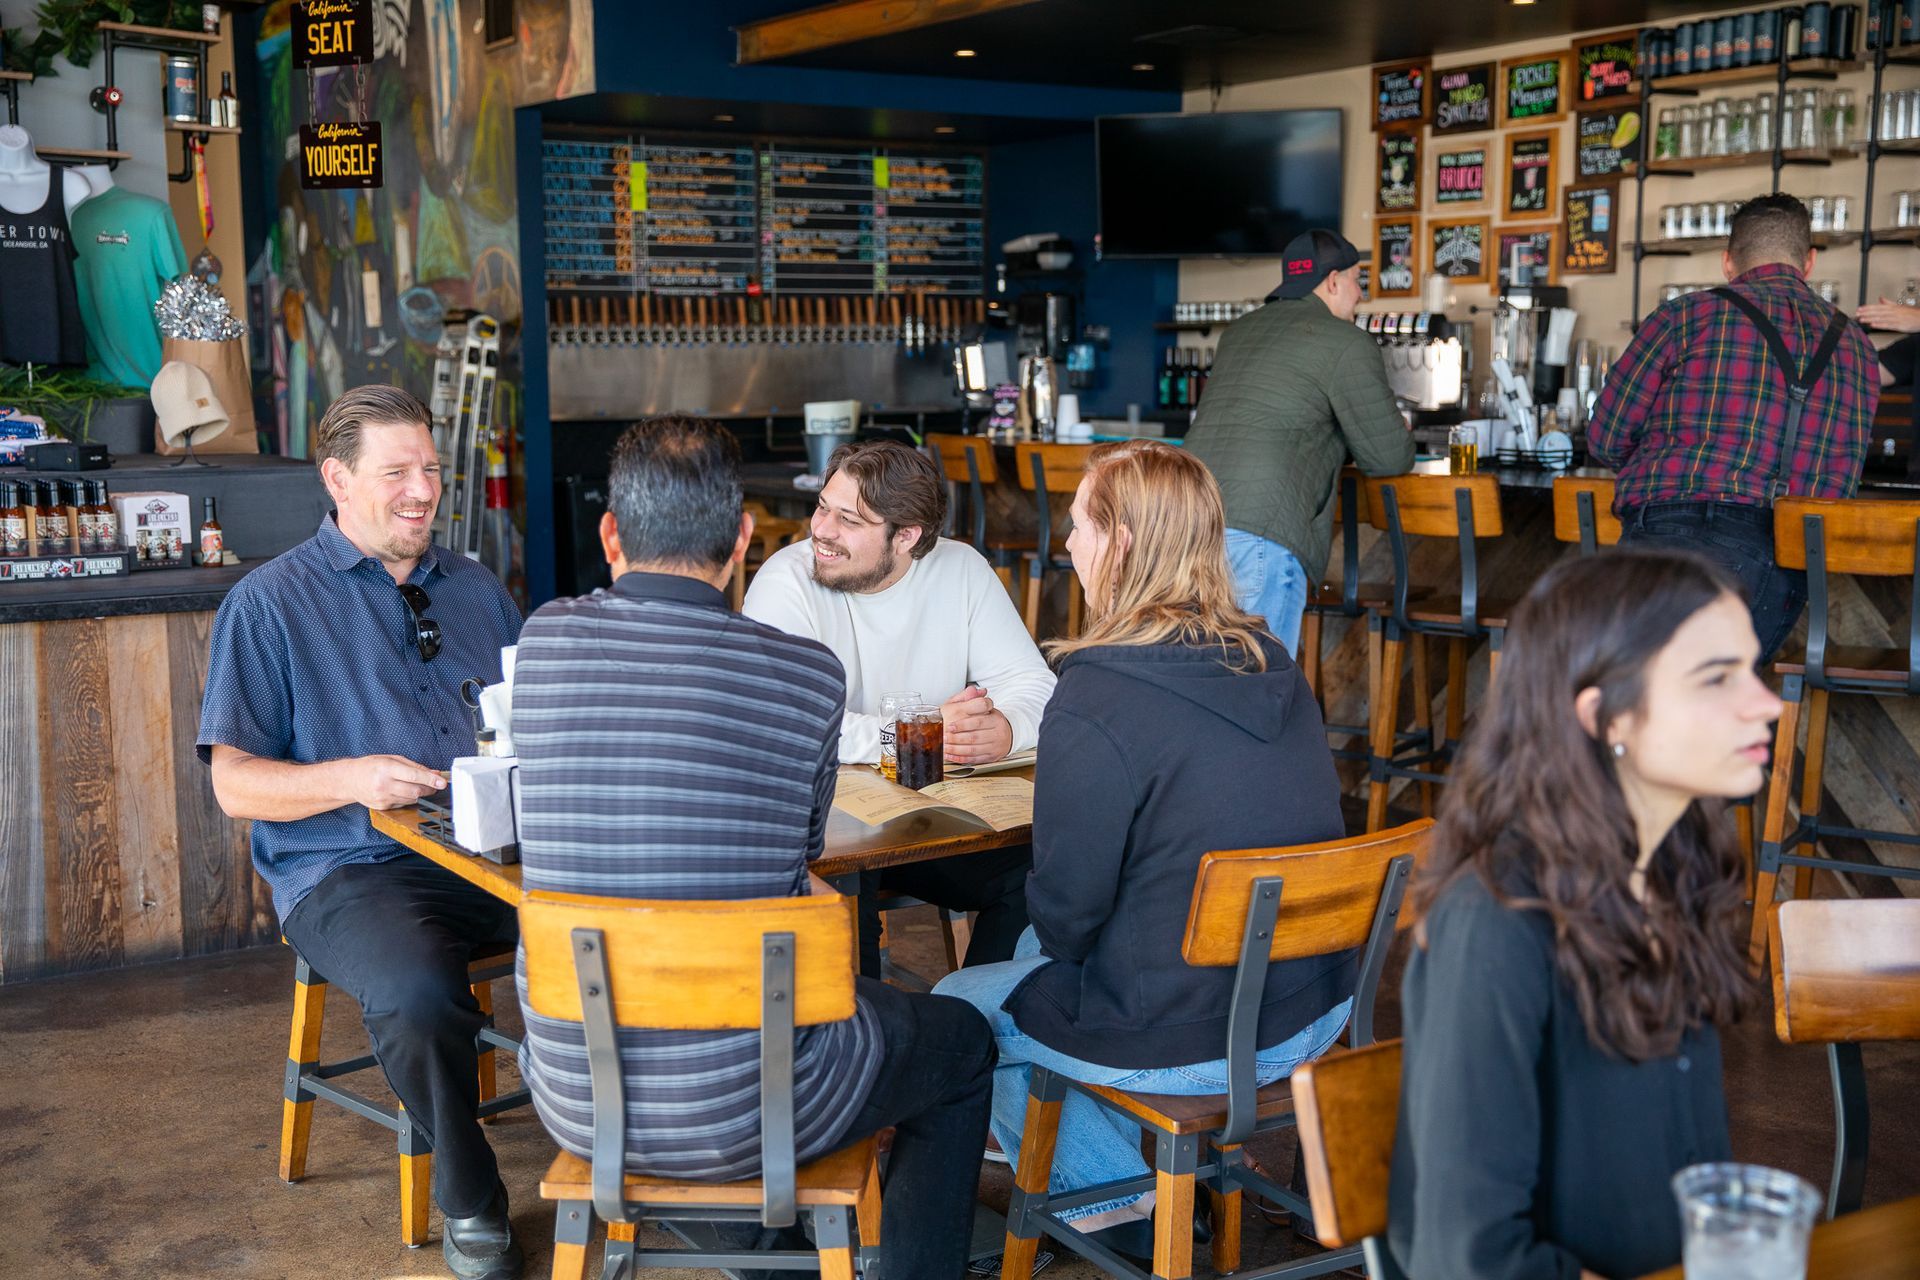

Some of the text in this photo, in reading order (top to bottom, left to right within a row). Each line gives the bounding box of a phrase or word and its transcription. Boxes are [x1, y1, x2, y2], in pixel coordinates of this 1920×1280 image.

[308, 0, 353, 19] California
[308, 20, 356, 55] SEAT
[317, 124, 363, 142] California
[305, 144, 378, 177] YOURSELF
